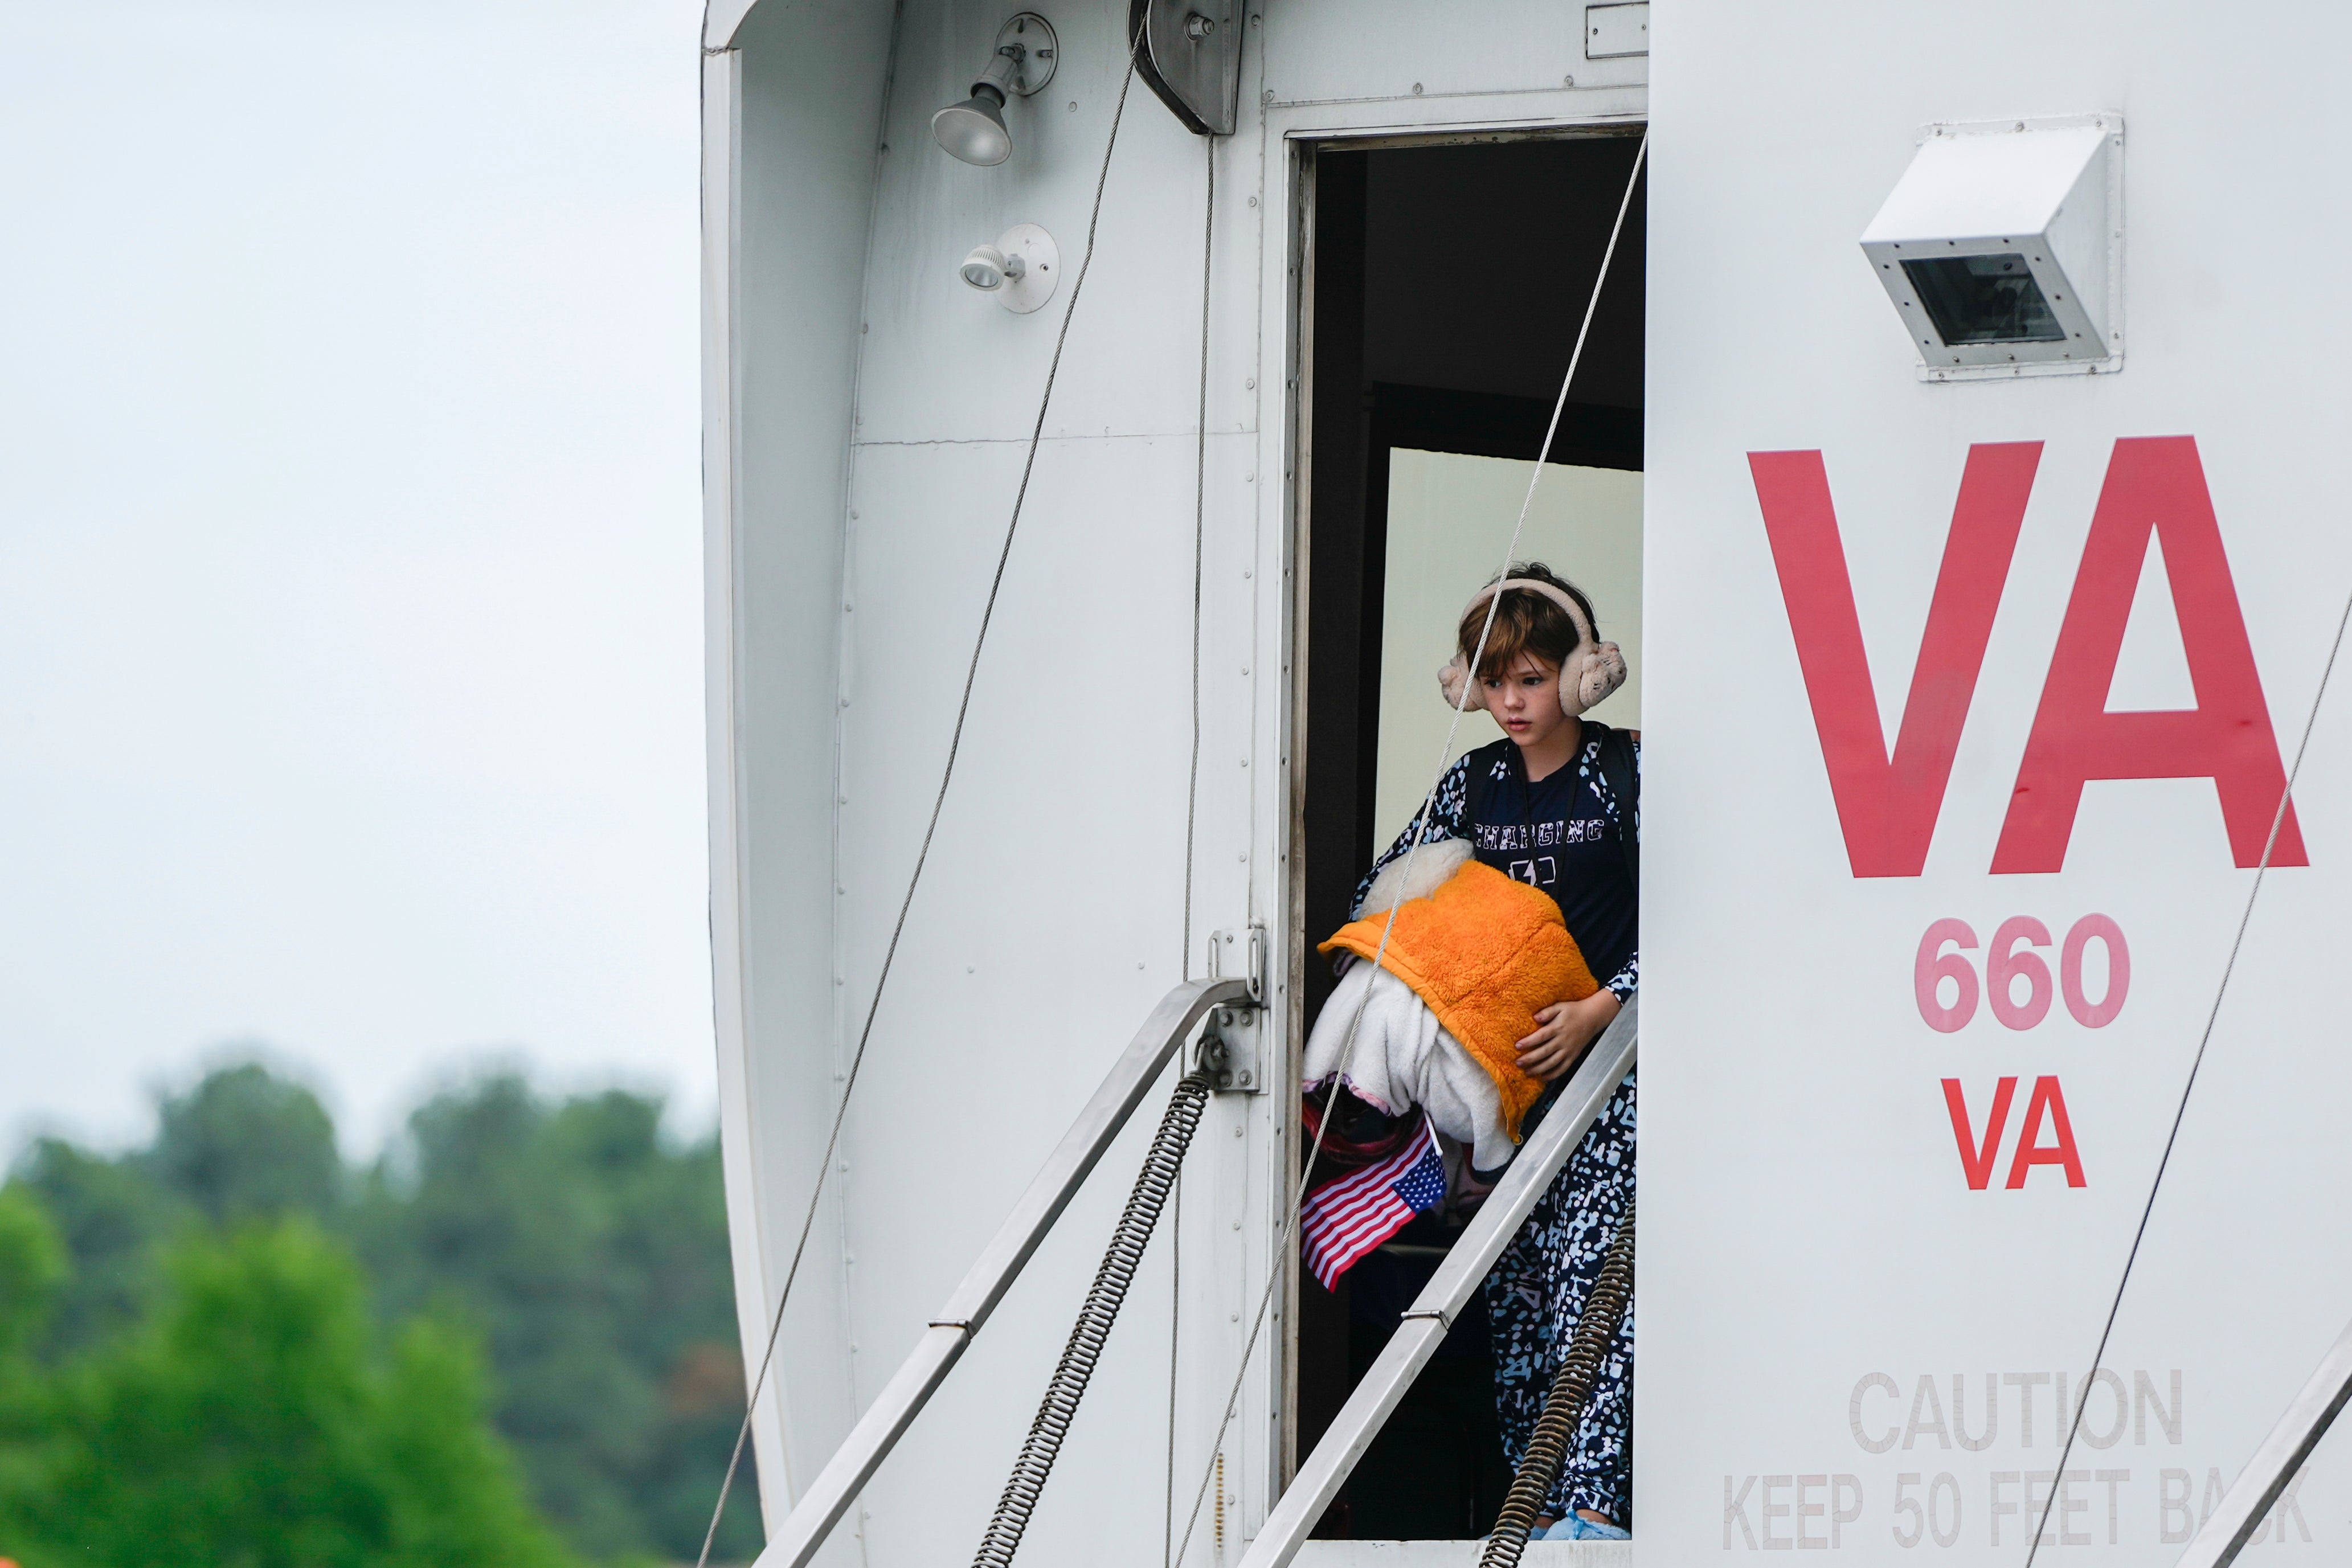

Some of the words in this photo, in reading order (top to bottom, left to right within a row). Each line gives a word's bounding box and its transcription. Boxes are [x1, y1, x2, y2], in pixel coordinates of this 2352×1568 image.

[1747, 435, 2310, 878] VA
[1915, 913, 2130, 1033] 660
[1941, 1075, 2087, 1190] VA
[1849, 1368, 2182, 1454] CAUTION
[1723, 1474, 1863, 1550] KEEP
[1892, 1471, 1962, 1548] 50
[1990, 1469, 2130, 1546] FEET
[2159, 1466, 2313, 1545] BAK
